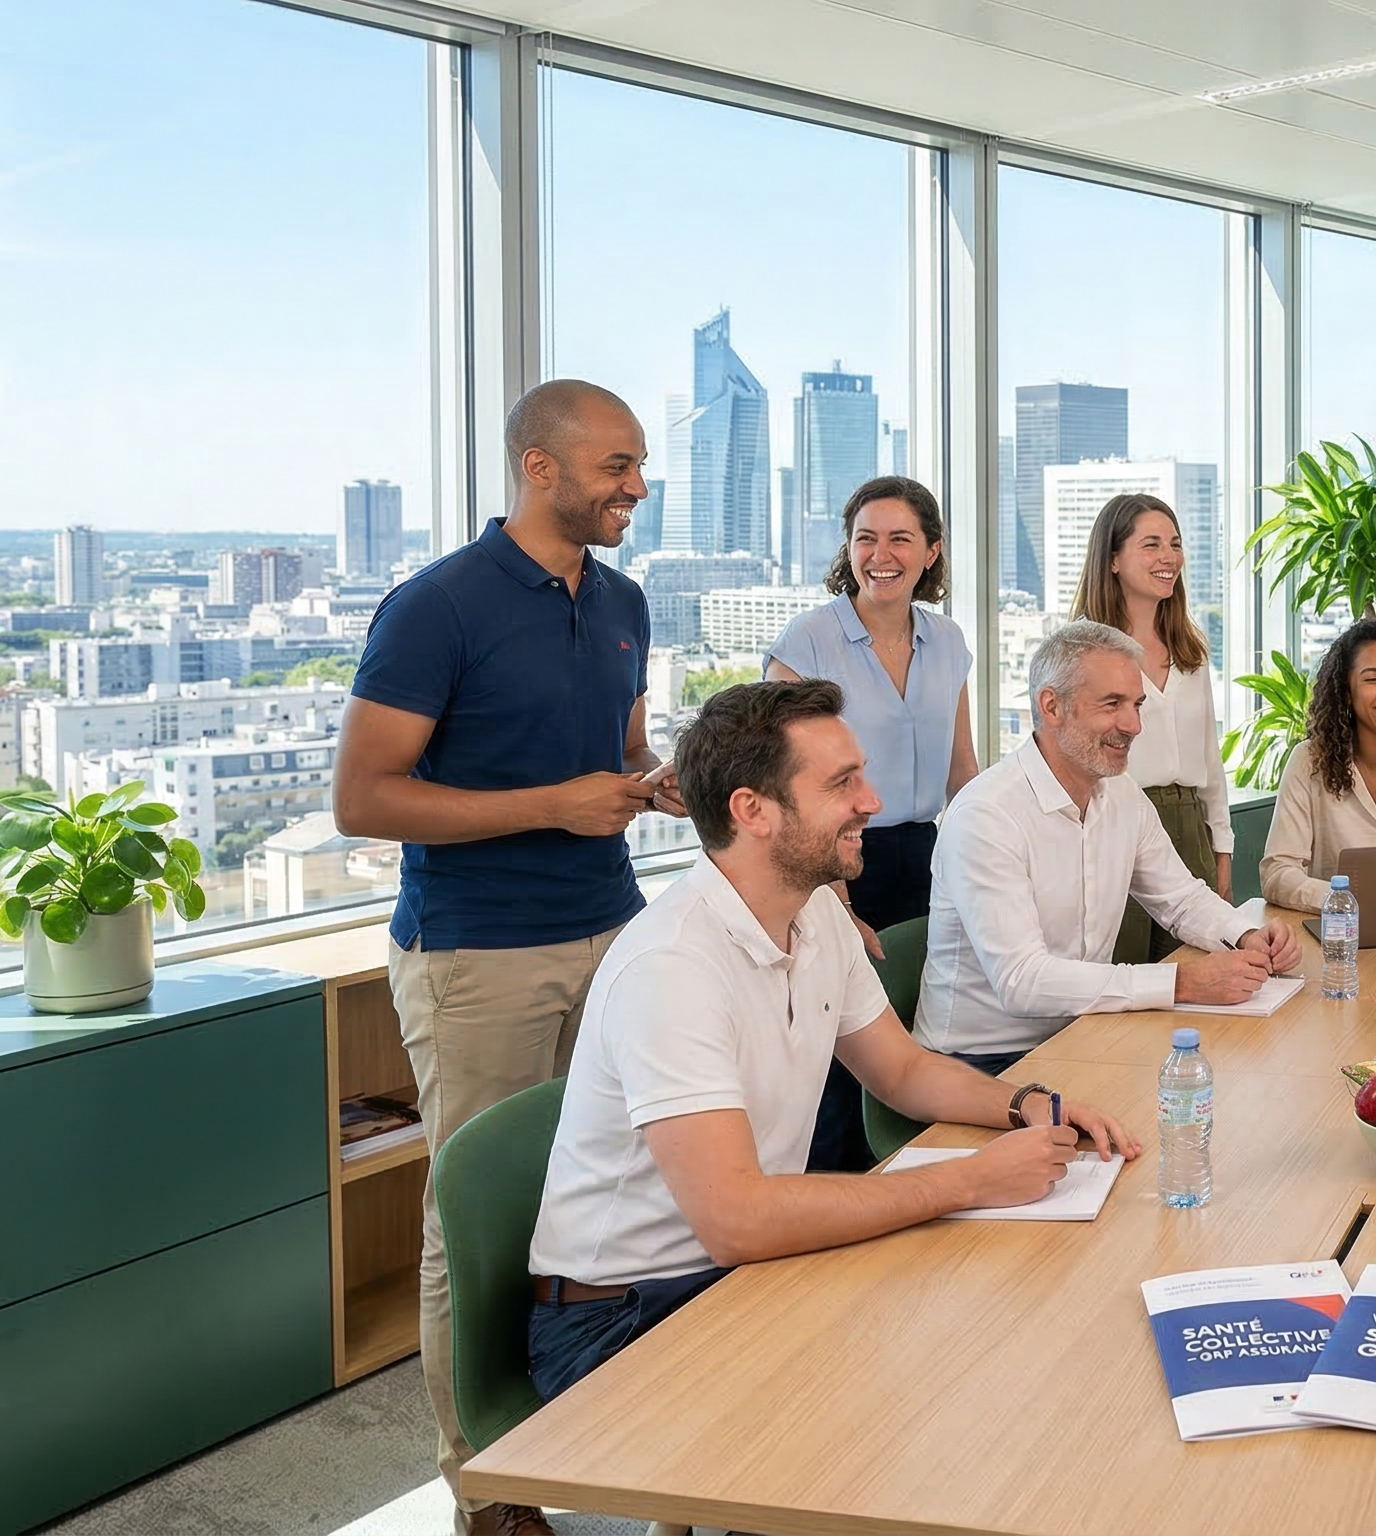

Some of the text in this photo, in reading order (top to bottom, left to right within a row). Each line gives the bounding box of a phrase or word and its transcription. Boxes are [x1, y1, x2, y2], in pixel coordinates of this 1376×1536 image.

[1182, 1316, 1264, 1341] SANTÉ
[1185, 1328, 1331, 1353] COLLECTIVE
[1238, 1342, 1327, 1358] ASSURANC
